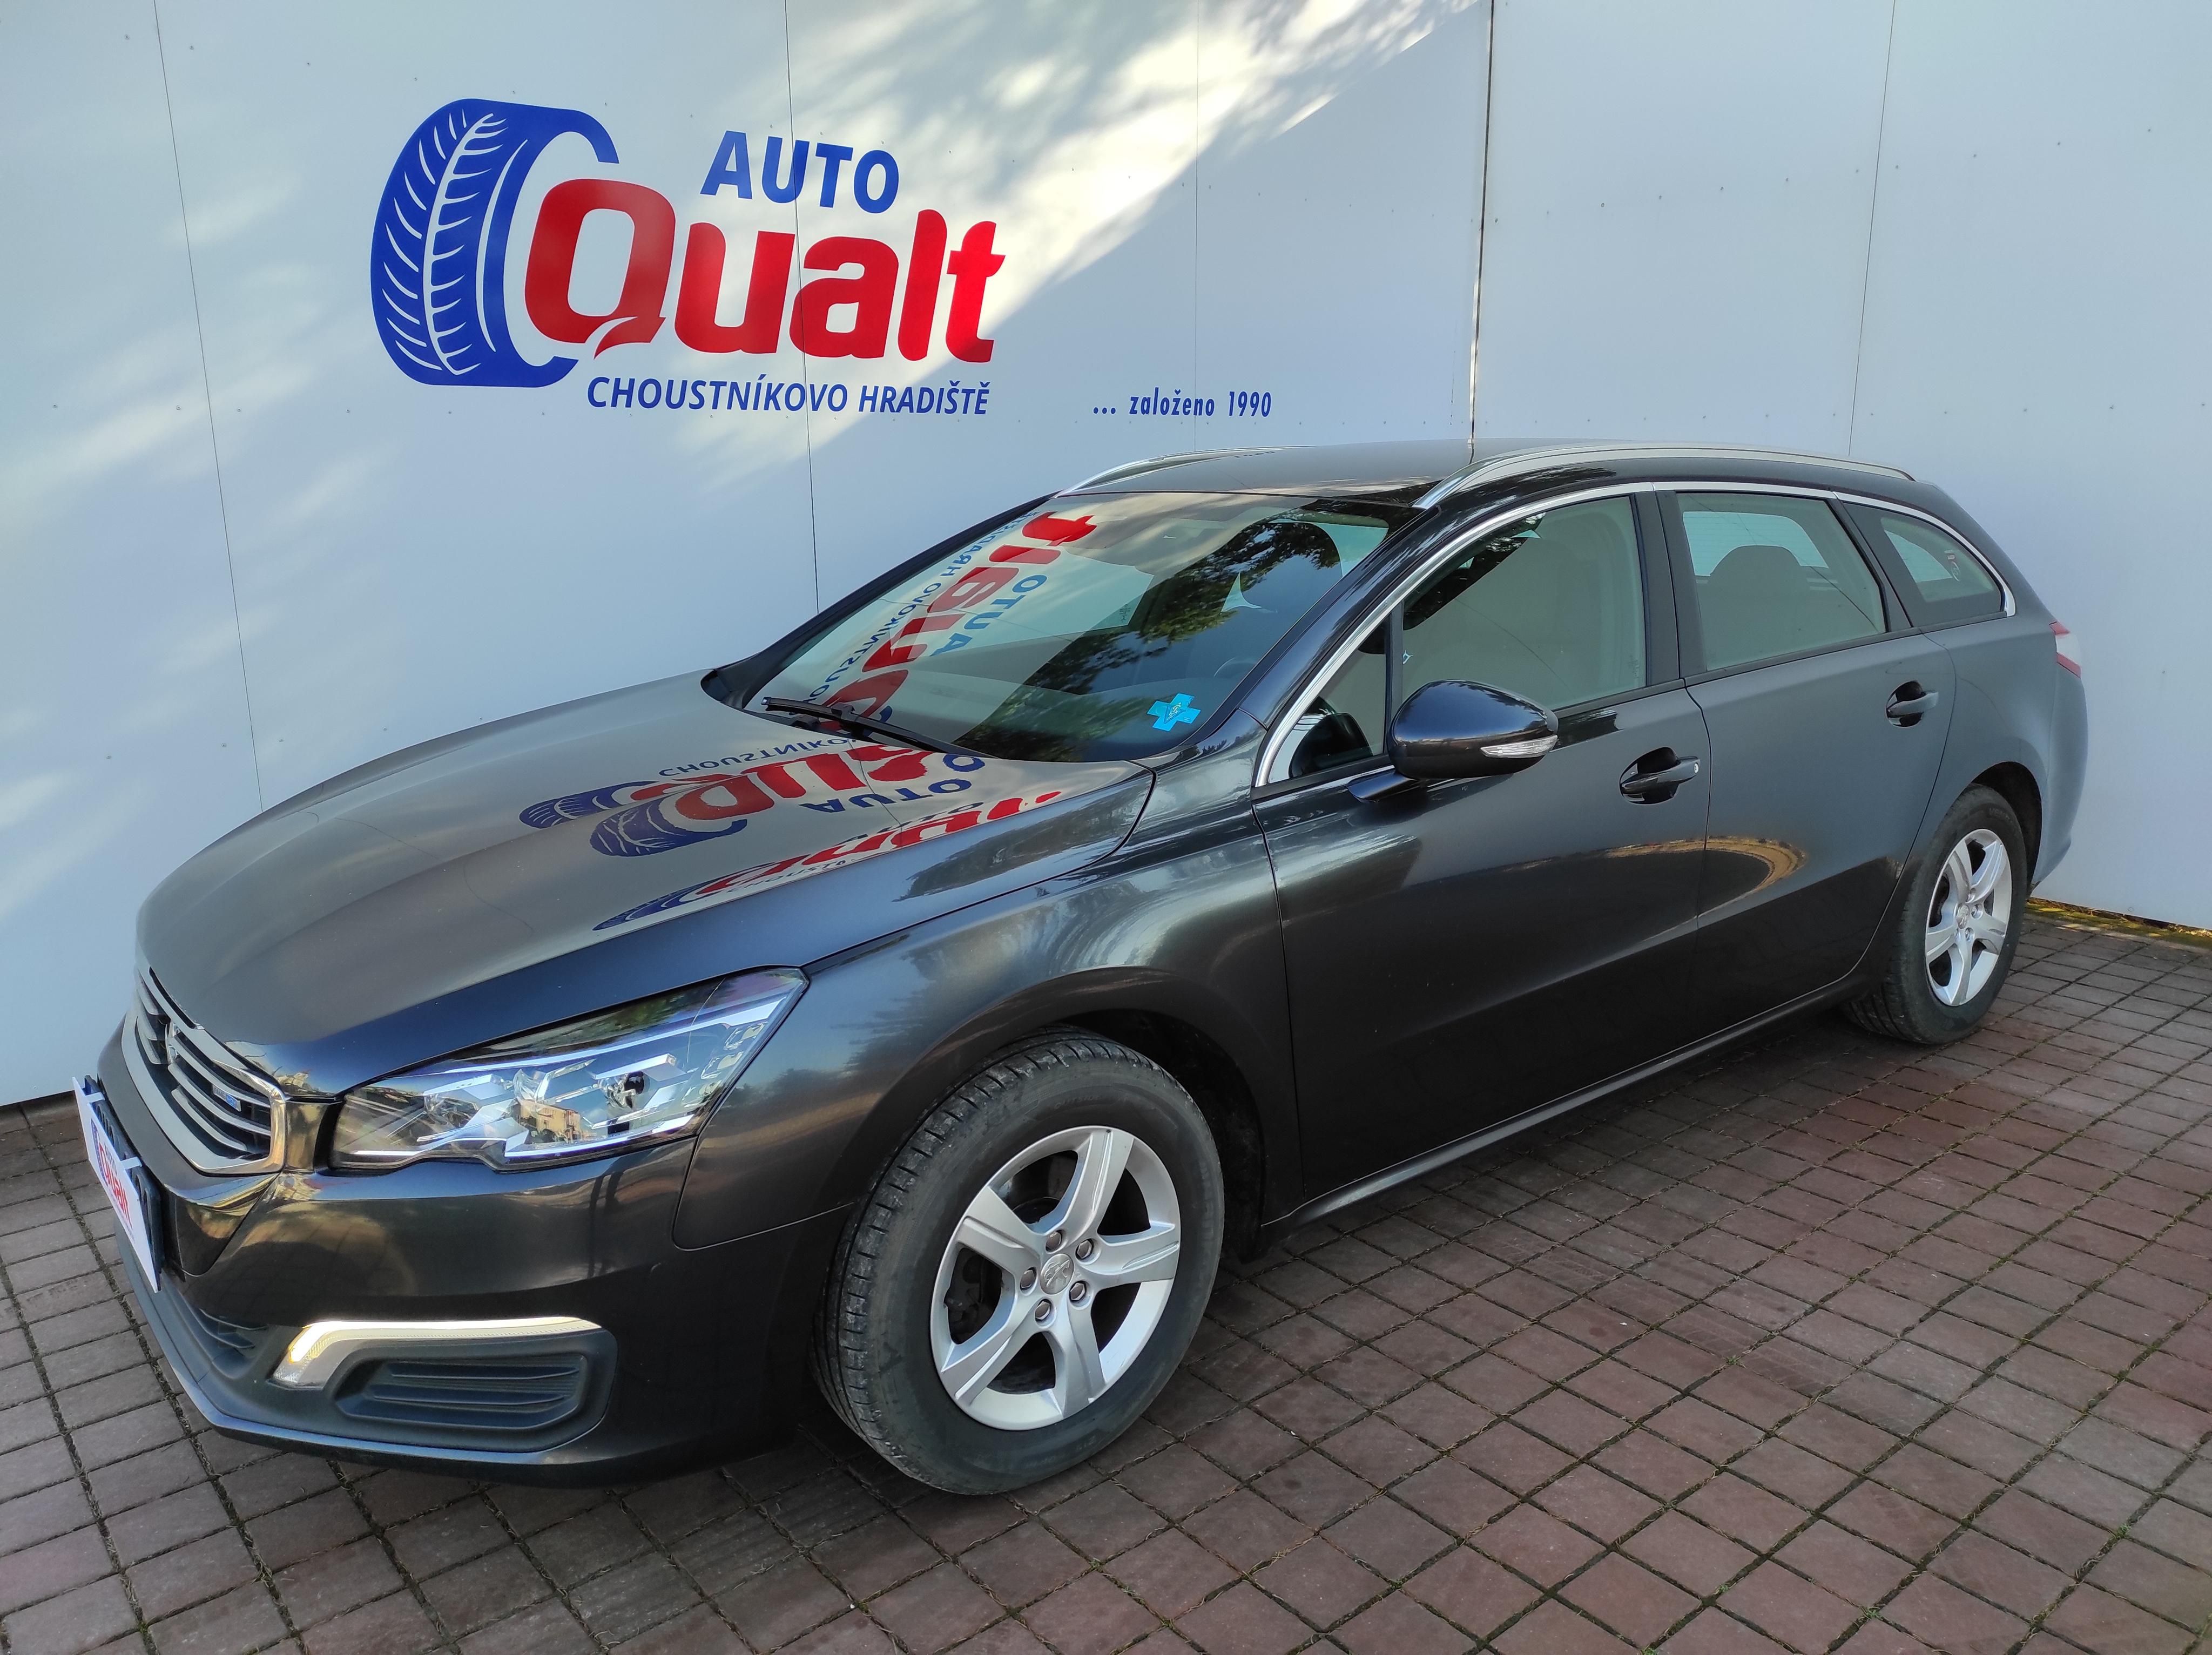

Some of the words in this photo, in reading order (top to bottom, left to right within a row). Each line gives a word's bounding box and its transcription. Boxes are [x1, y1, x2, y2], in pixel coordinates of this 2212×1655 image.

[699, 130, 900, 214] AUTO
[524, 179, 1006, 363] Qualt
[586, 374, 848, 412] CHOUSTNÍKOVO
[858, 380, 990, 415] HRADIŠTĚ
[1129, 387, 1215, 417] založeno
[1228, 391, 1272, 417] 1990
